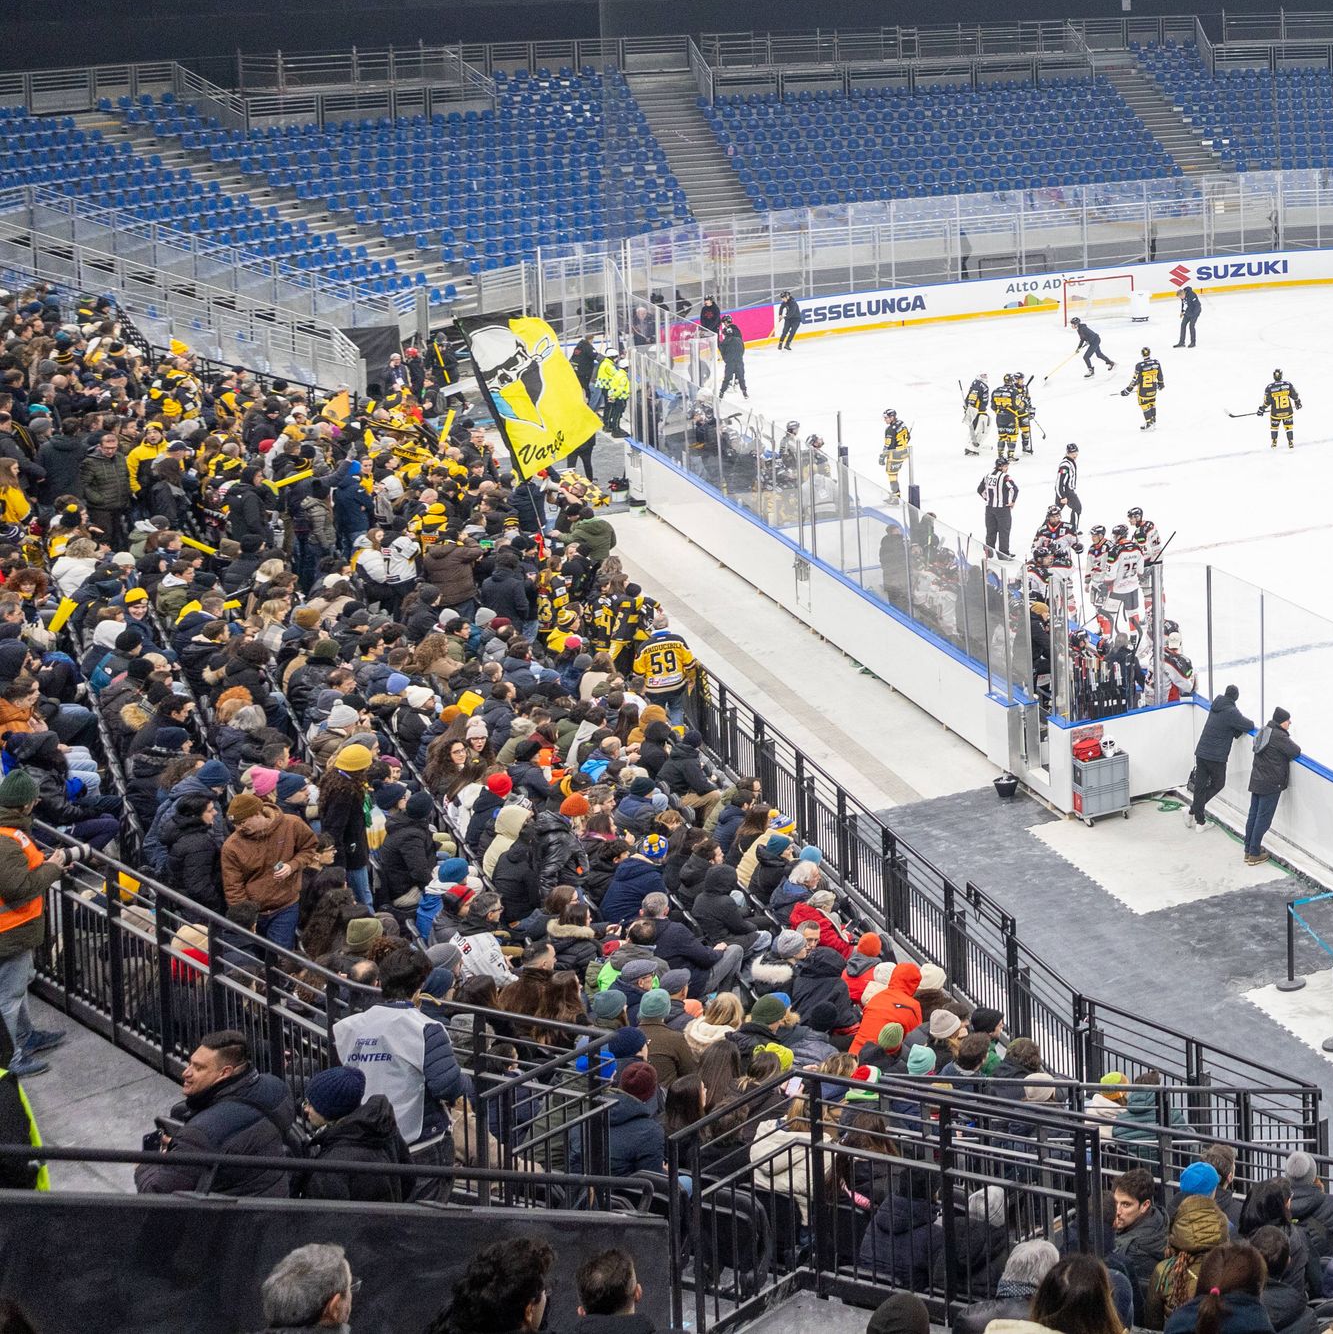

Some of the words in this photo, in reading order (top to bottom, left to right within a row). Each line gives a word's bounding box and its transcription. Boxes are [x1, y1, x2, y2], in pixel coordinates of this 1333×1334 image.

[1196, 260, 1288, 281] SUZUKI
[800, 294, 927, 325] ESSELUNGA
[650, 650, 677, 675] 59
